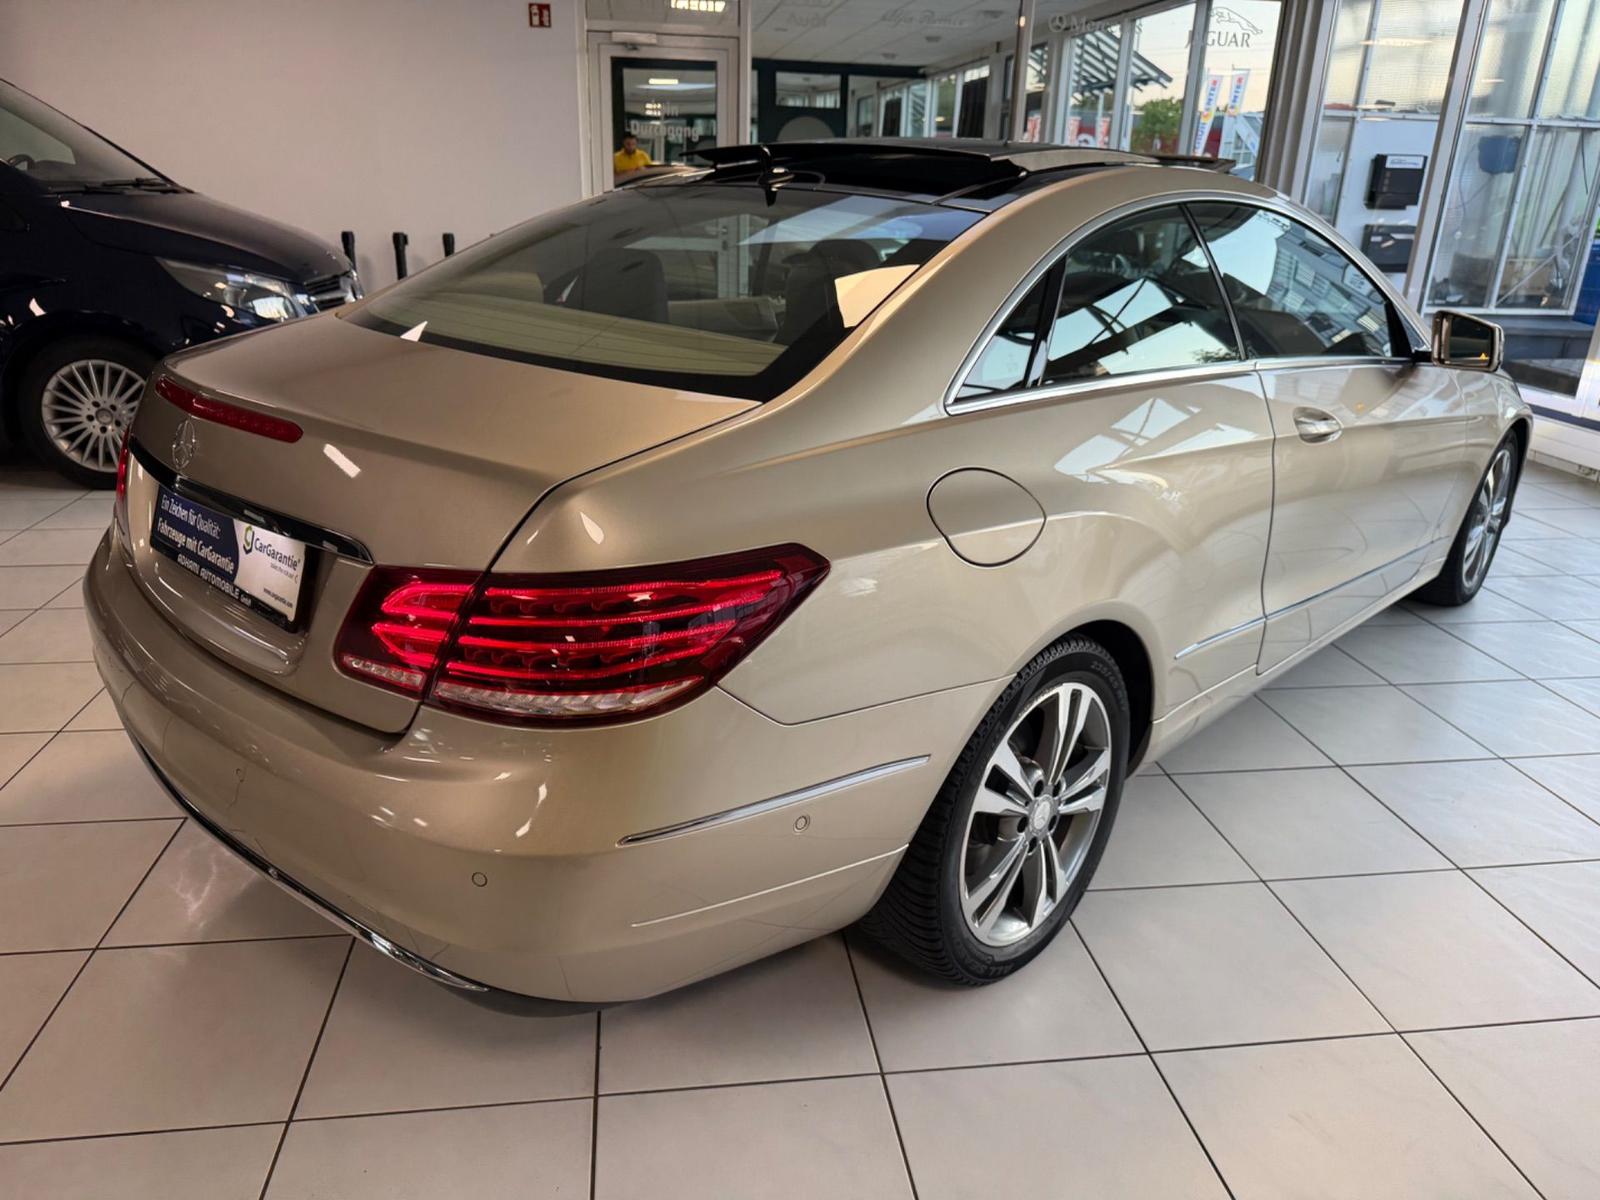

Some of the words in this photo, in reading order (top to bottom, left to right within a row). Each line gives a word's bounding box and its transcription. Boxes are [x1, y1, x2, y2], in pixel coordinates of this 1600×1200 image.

[1185, 30, 1251, 48] JGUAR
[630, 120, 700, 142] Durchgang
[161, 494, 170, 511] Ein
[169, 498, 188, 522] Zeichen
[187, 508, 197, 527] für
[158, 516, 186, 548] Fahrzeuge
[185, 531, 198, 553] mit
[197, 540, 234, 575] CarGarantie
[254, 538, 298, 571] CarGarantie
[200, 567, 240, 599] AUTOMOBILE
